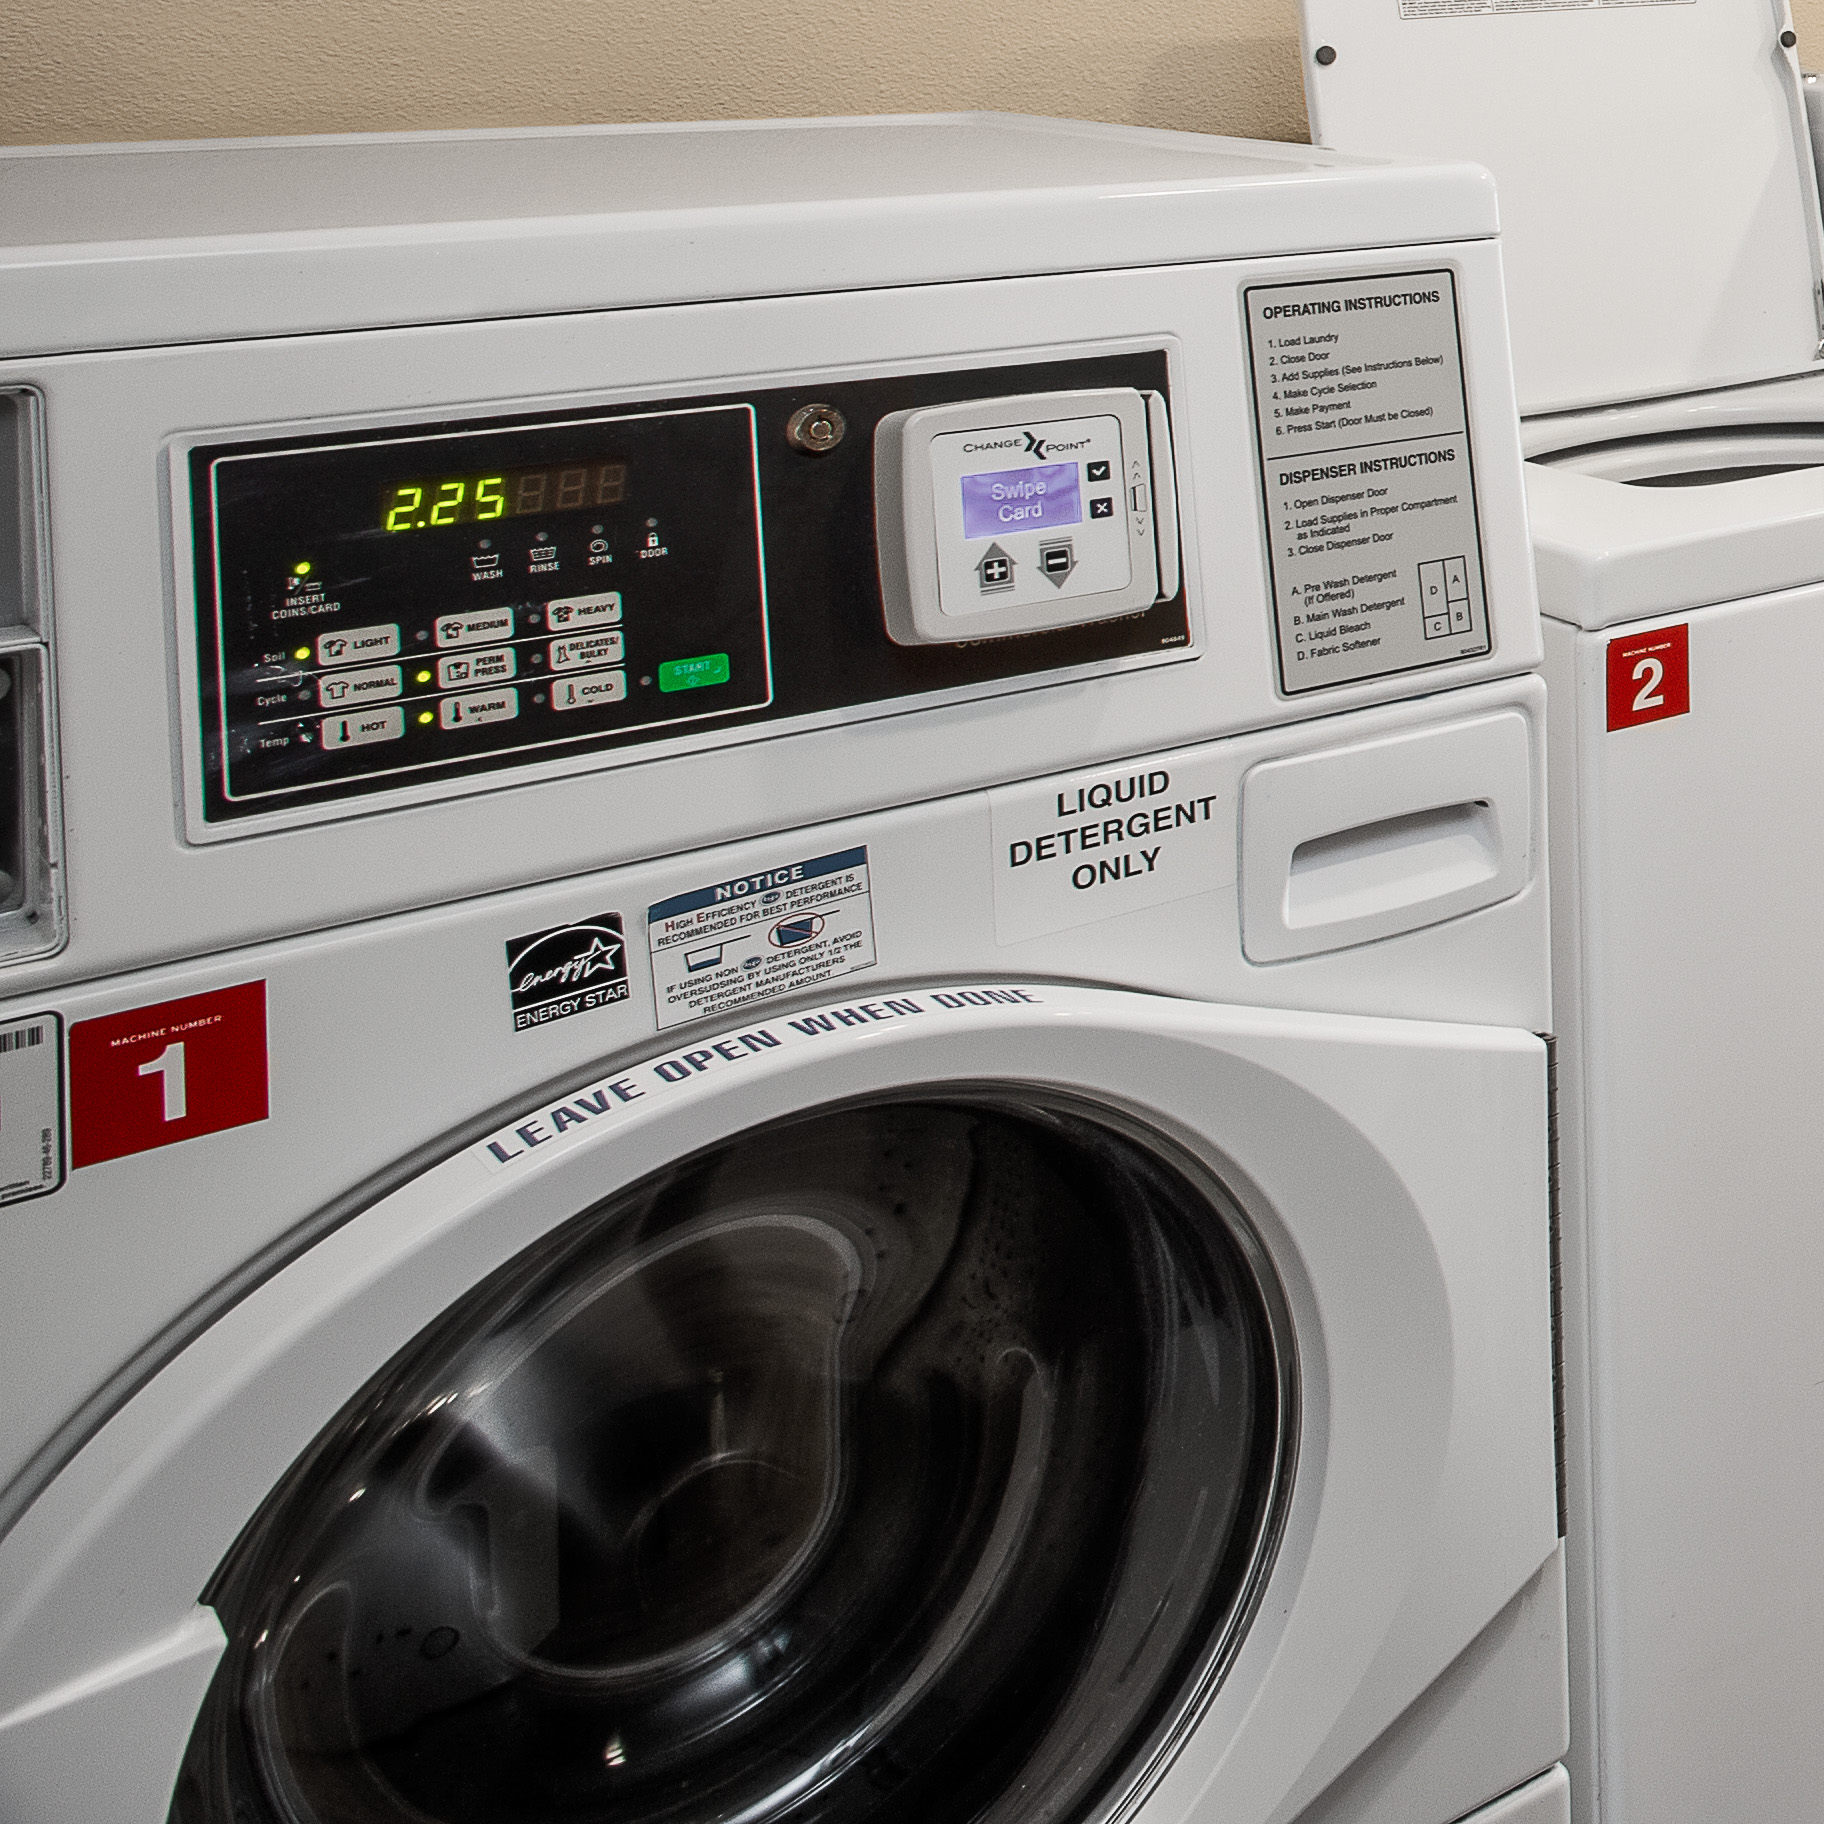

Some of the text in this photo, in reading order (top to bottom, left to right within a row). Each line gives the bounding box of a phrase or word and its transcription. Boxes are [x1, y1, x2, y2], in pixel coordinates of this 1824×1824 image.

[1263, 291, 1440, 319] OPERATING INSTRUCTIONS
[1268, 333, 1339, 348] 1. Load Laundry
[1270, 352, 1330, 366] 2. Close Door
[1271, 355, 1444, 383] 3. Add Supplies (See Instructions Below)
[1273, 381, 1377, 400] 4. Make Cycle Selection
[1274, 401, 1351, 418] 5. Make Payment
[1276, 407, 1433, 435] 6. Press Start (Door Must be Closed)
[963, 439, 1022, 453] CHANGE
[1280, 449, 1455, 485] DISPENSER INSTRUCTIONS
[992, 481, 1047, 501] Swipe
[387, 478, 504, 530] 2.25
[999, 502, 1042, 522] Card
[589, 555, 612, 565] SPIN
[640, 547, 668, 558] DOOR
[529, 561, 560, 572] RINSE
[472, 570, 503, 581] WASH
[286, 593, 326, 606] INSERT
[272, 601, 340, 620] COINS/CARD
[578, 602, 615, 616] HEAVY
[467, 619, 508, 633] MEDIUM
[354, 636, 390, 649] LIGHT
[569, 637, 619, 652] DELICATES/
[264, 651, 285, 663] Soil
[579, 648, 609, 659] BULKY
[475, 656, 504, 667] PERM
[673, 660, 711, 675] START
[475, 664, 507, 677] PRESS
[353, 677, 397, 691] NORMAL
[582, 682, 613, 695] COLD
[1632, 658, 1663, 711] 2
[257, 694, 287, 707] Cycle
[469, 701, 506, 713] WARM
[362, 720, 387, 733] HOT
[260, 736, 289, 749] Temp
[1058, 771, 1170, 817] LIQUID
[1010, 795, 1216, 867] DETERGENT
[1072, 846, 1161, 889] ONLY
[715, 866, 804, 901] NOTICE
[786, 878, 842, 899] DETERGENT
[846, 874, 854, 882] IS
[657, 920, 737, 946] RECOMMENDED
[740, 911, 760, 923] FOR
[763, 904, 788, 917] BEST
[790, 883, 863, 910] PERFORMANCE
[520, 955, 585, 992] energy
[517, 985, 628, 1027] ENERGY STAR
[111, 1015, 222, 1047] MACHINE NUMBER
[139, 1042, 186, 1121] 1
[487, 989, 1044, 1163] LEAVE OPEN WHEN DONE
